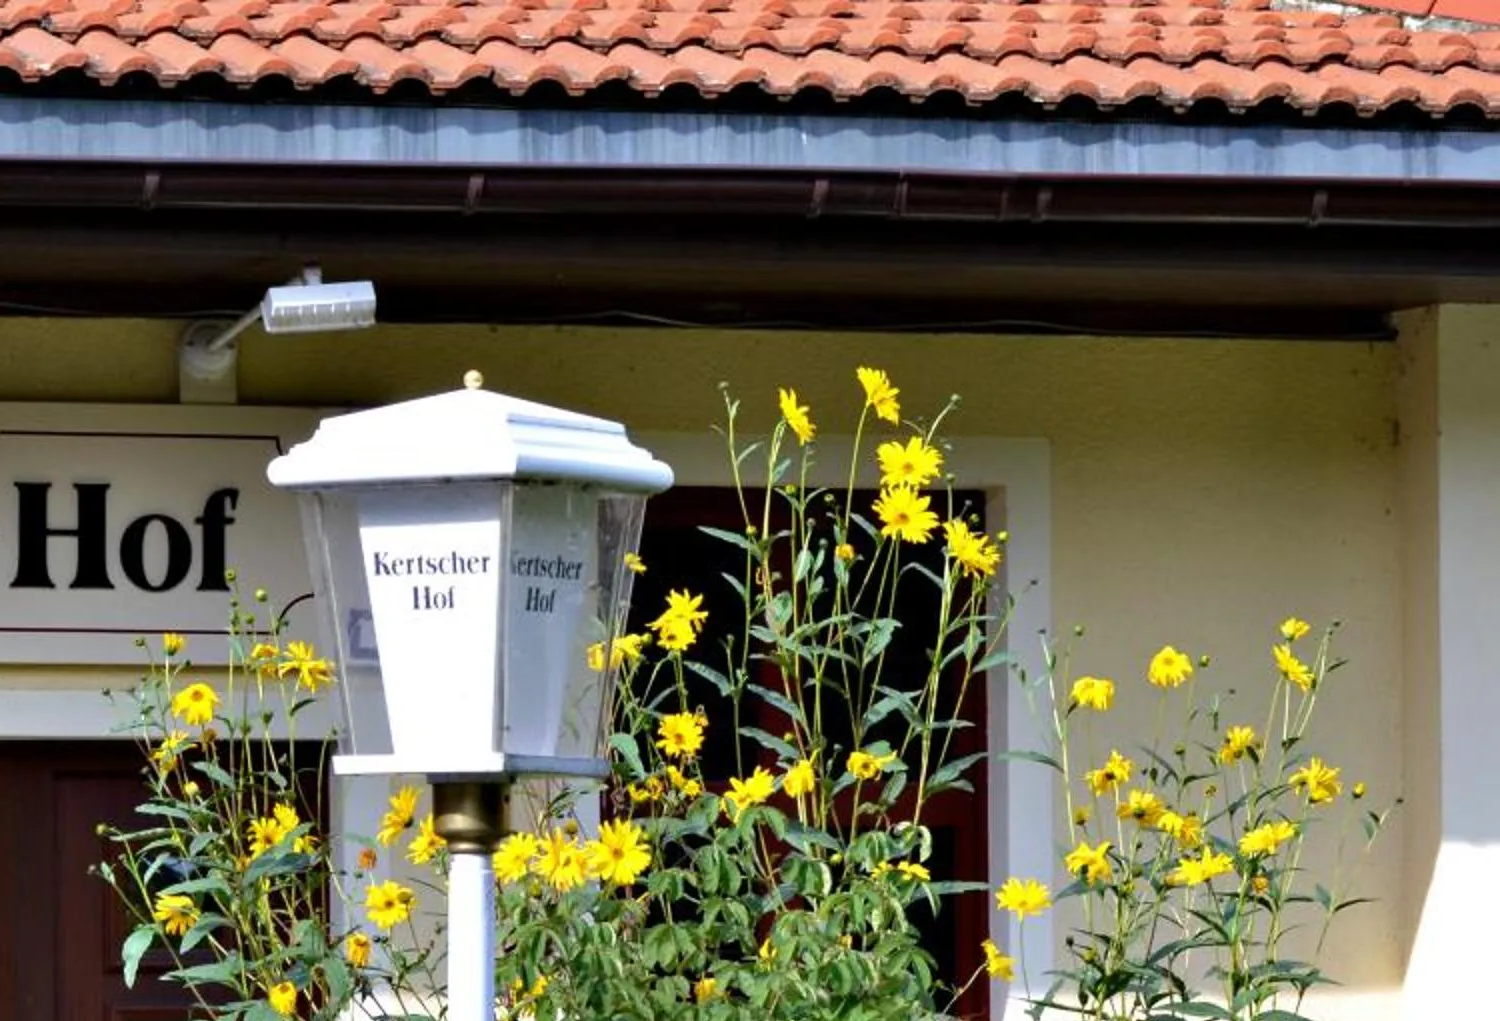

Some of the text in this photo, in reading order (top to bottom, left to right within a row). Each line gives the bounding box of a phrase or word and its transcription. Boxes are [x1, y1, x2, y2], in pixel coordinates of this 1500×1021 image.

[373, 551, 490, 576] Kertscher
[412, 585, 455, 611] Hof
[524, 586, 556, 613] Hof
